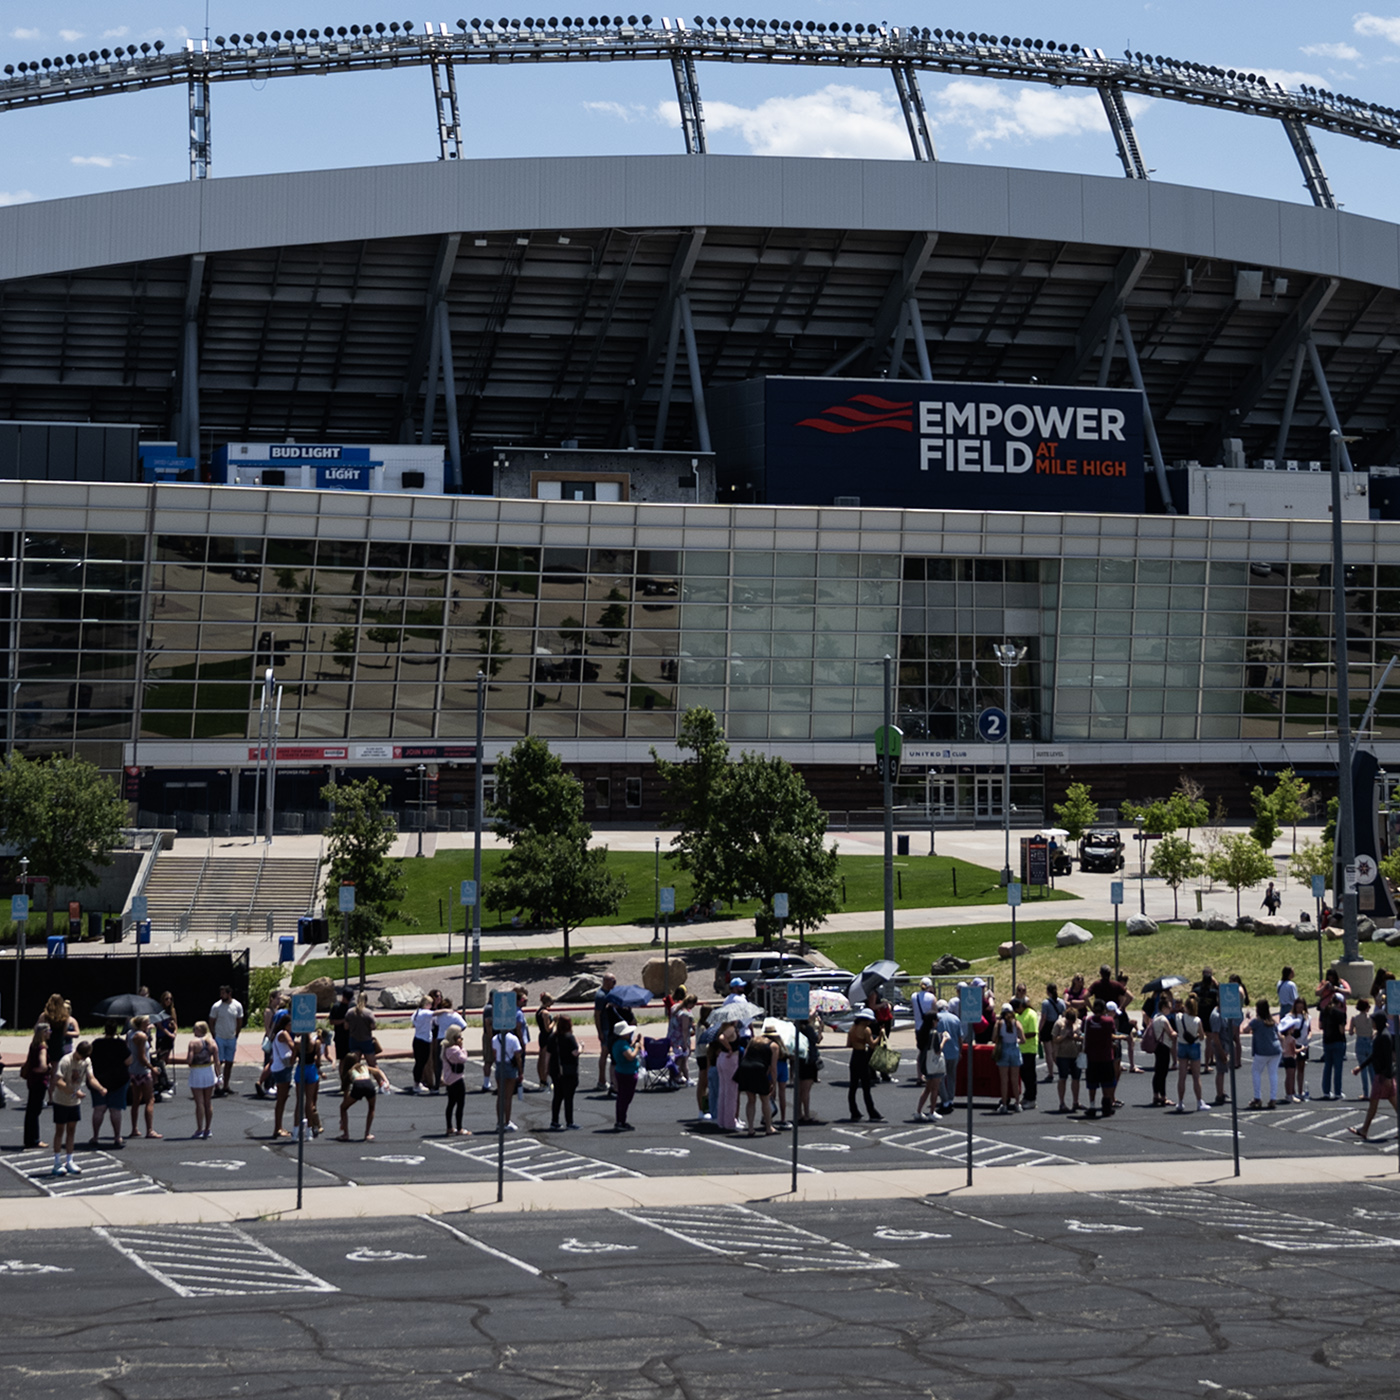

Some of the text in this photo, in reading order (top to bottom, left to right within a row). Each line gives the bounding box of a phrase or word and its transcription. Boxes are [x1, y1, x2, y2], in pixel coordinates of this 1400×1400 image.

[918, 400, 1126, 441] EMPOWER
[271, 446, 341, 459] BUD LIGHT
[919, 437, 1034, 474] FIELD
[1036, 442, 1058, 458] AT
[325, 469, 360, 480] LIGHT
[1035, 459, 1127, 477] MILE HIGH
[986, 715, 1001, 735] 2
[405, 748, 421, 756] JOIN
[890, 759, 897, 776] 9
